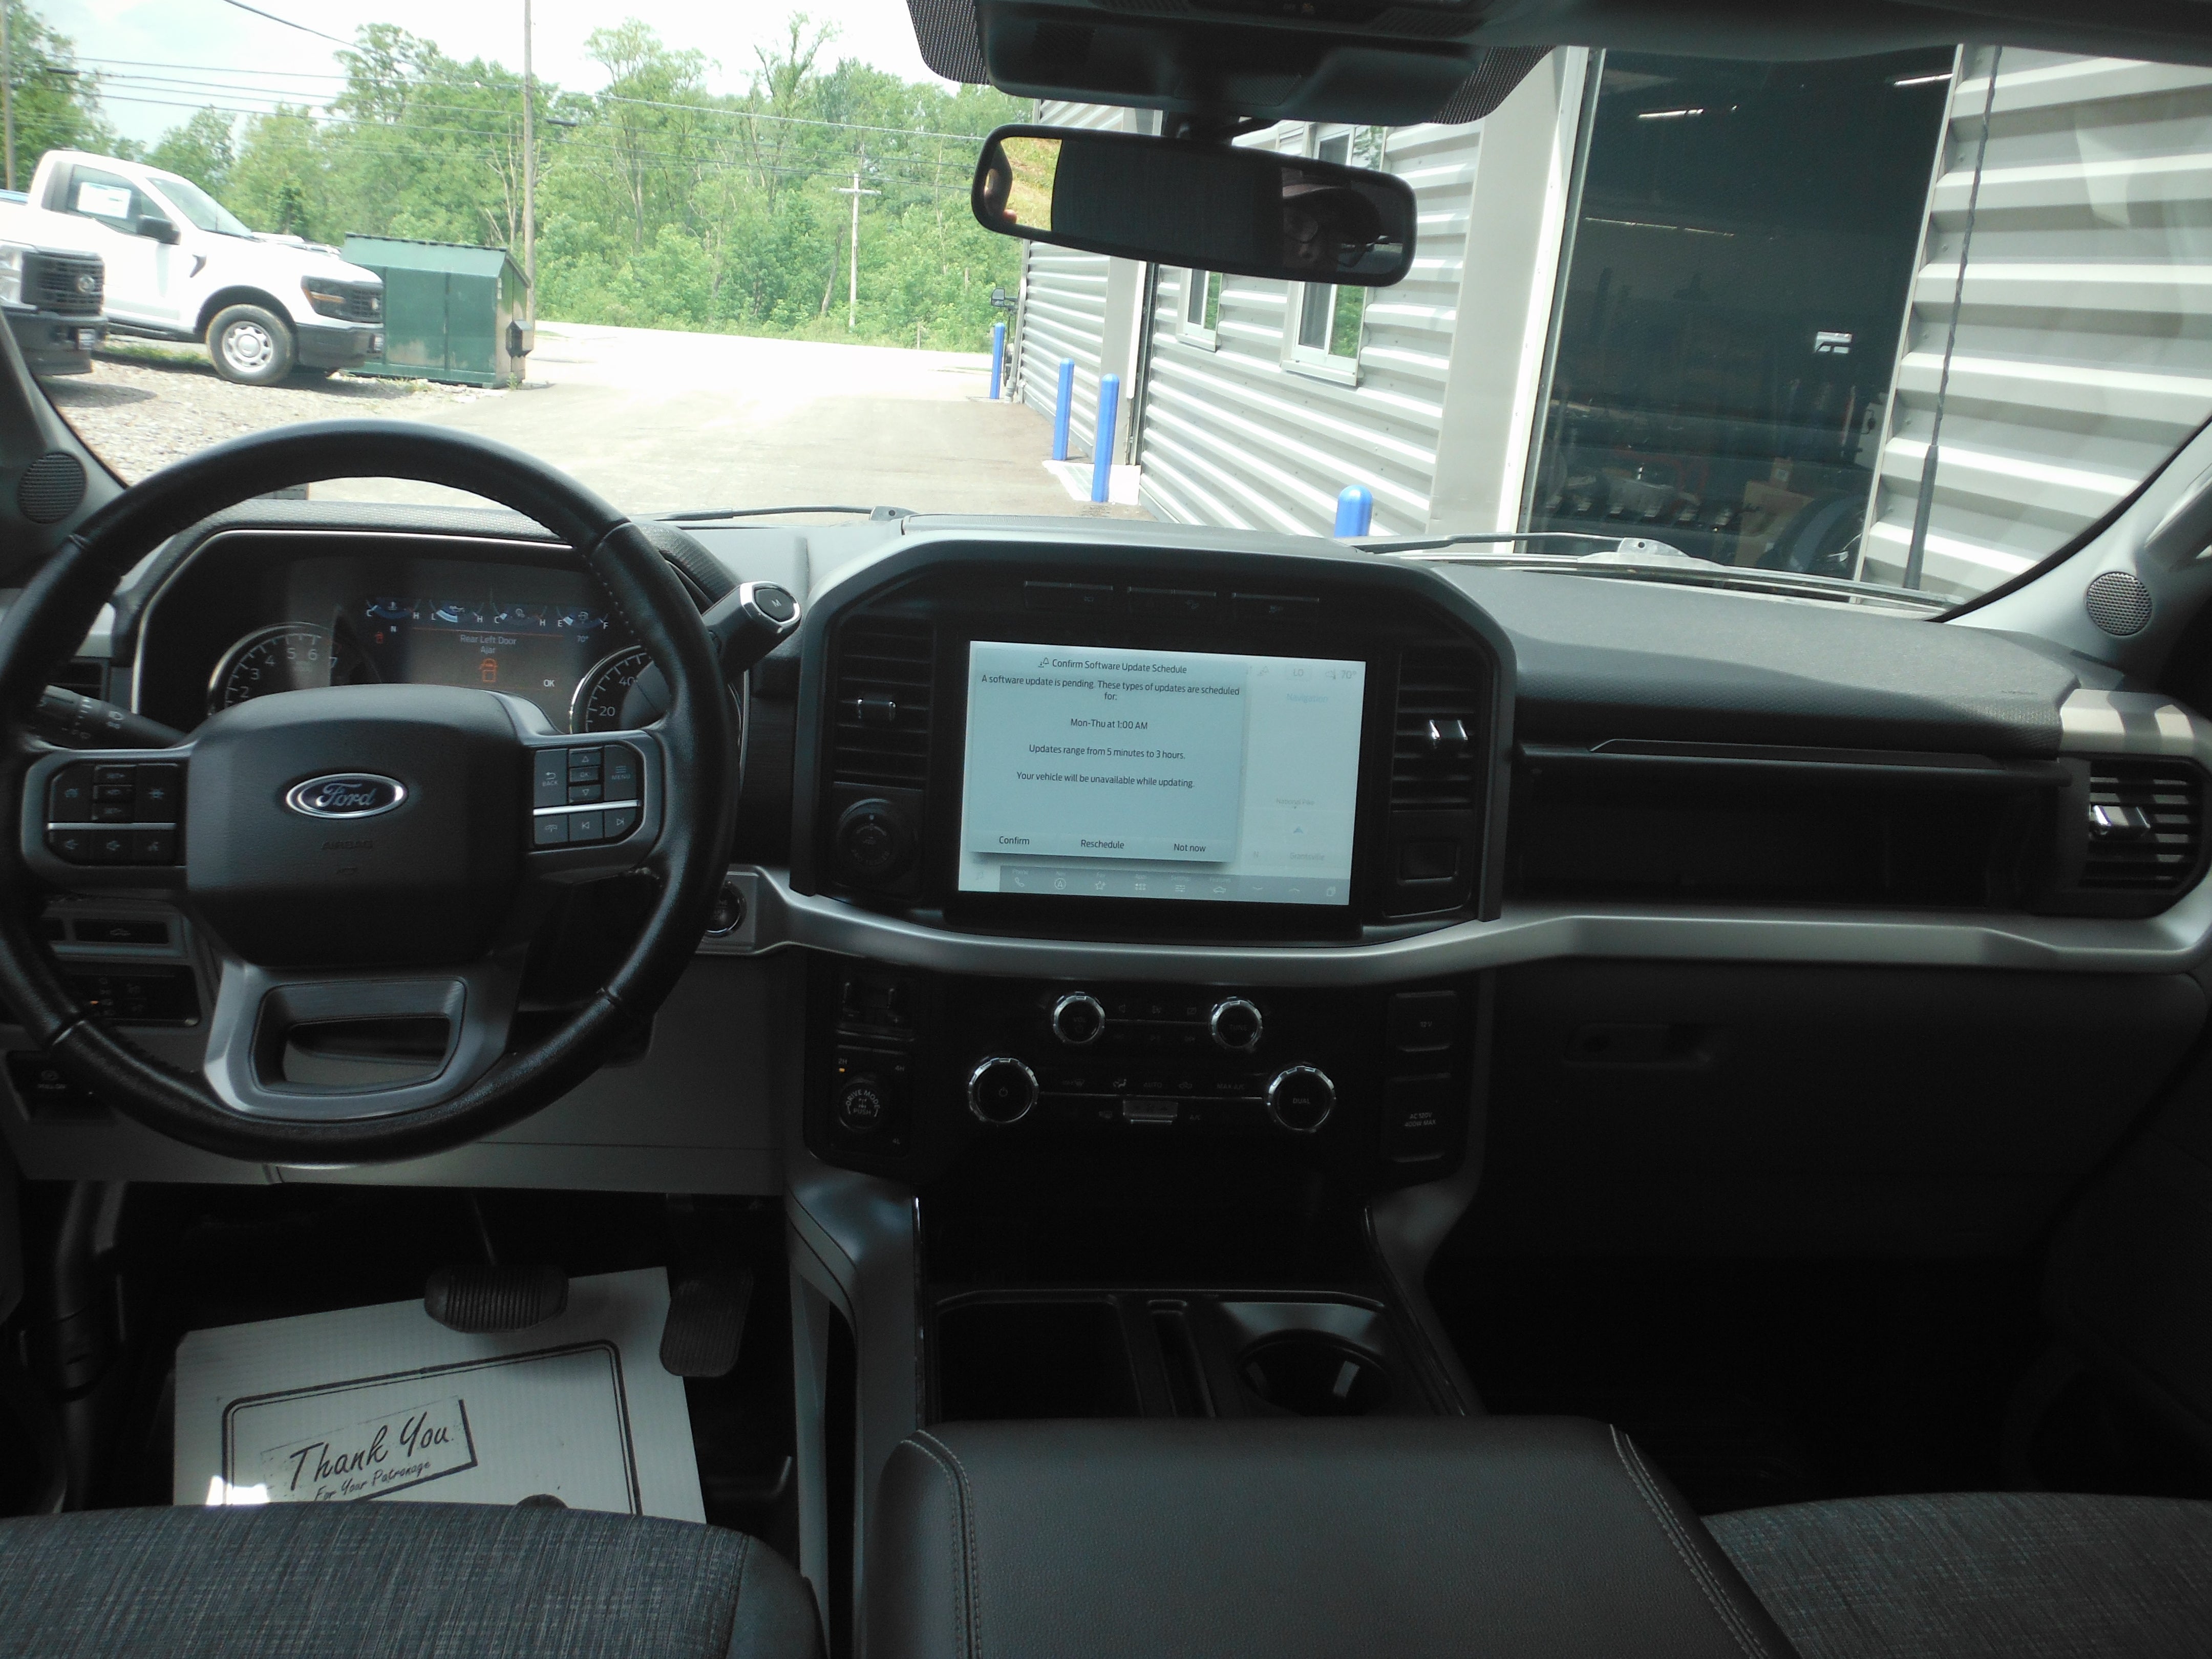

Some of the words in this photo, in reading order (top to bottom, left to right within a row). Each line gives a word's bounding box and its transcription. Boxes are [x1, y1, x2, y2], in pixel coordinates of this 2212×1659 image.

[431, 612, 436, 621] L
[477, 614, 483, 623] H
[494, 616, 500, 624] C
[539, 619, 546, 627] H
[557, 619, 563, 627] E
[603, 621, 608, 630] F
[460, 634, 478, 643] Rear
[479, 634, 496, 644] Left
[498, 635, 517, 645] Door
[287, 648, 295, 659] 5
[308, 649, 318, 661] 6
[480, 646, 496, 655] Ajar
[265, 655, 275, 667] 4
[329, 656, 338, 668] 7
[1052, 658, 1083, 668] Confirm
[1085, 661, 1120, 670] Software
[1122, 663, 1151, 672] Update
[1152, 664, 1187, 674] Schedule
[250, 668, 260, 680] 3
[543, 678, 555, 687] OK
[619, 676, 635, 686] 40
[989, 675, 1024, 685] software
[1026, 677, 1053, 686] update
[1054, 678, 1061, 687] is
[1098, 680, 1121, 690] These
[1122, 682, 1143, 691] types
[1145, 683, 1154, 691] of
[1155, 684, 1186, 693] updates
[1201, 686, 1240, 695] scheduled
[240, 686, 249, 698] 2
[1104, 692, 1117, 700] for:
[599, 706, 616, 717] 20
[1071, 718, 1106, 728] Mon-Thu
[1107, 720, 1115, 729] at
[1117, 720, 1134, 729] 1:00
[1135, 721, 1148, 730] AM
[1029, 744, 1061, 754] Updates
[1063, 747, 1085, 756] range
[1087, 747, 1105, 755] from
[1107, 748, 1112, 756] 5
[1113, 748, 1144, 757] minutes
[1156, 750, 1161, 758] 3
[1162, 751, 1185, 759] hours.
[1017, 772, 1034, 780] Your
[1036, 773, 1062, 781] vehicle
[1064, 774, 1078, 782] will
[1079, 774, 1089, 782] be
[1091, 775, 1135, 784] unavailable
[1137, 777, 1157, 785] while
[316, 783, 376, 807] Ford
[999, 836, 1030, 845] Confirm
[1080, 839, 1124, 849] Reschedule
[1174, 843, 1188, 852] Not
[845, 1089, 863, 1107] DRIVE
[863, 1090, 881, 1109] MODE
[290, 1424, 388, 1491] Thank
[314, 1485, 336, 1501] For
[341, 1478, 369, 1496] Your
[373, 1460, 431, 1486] Patronage
